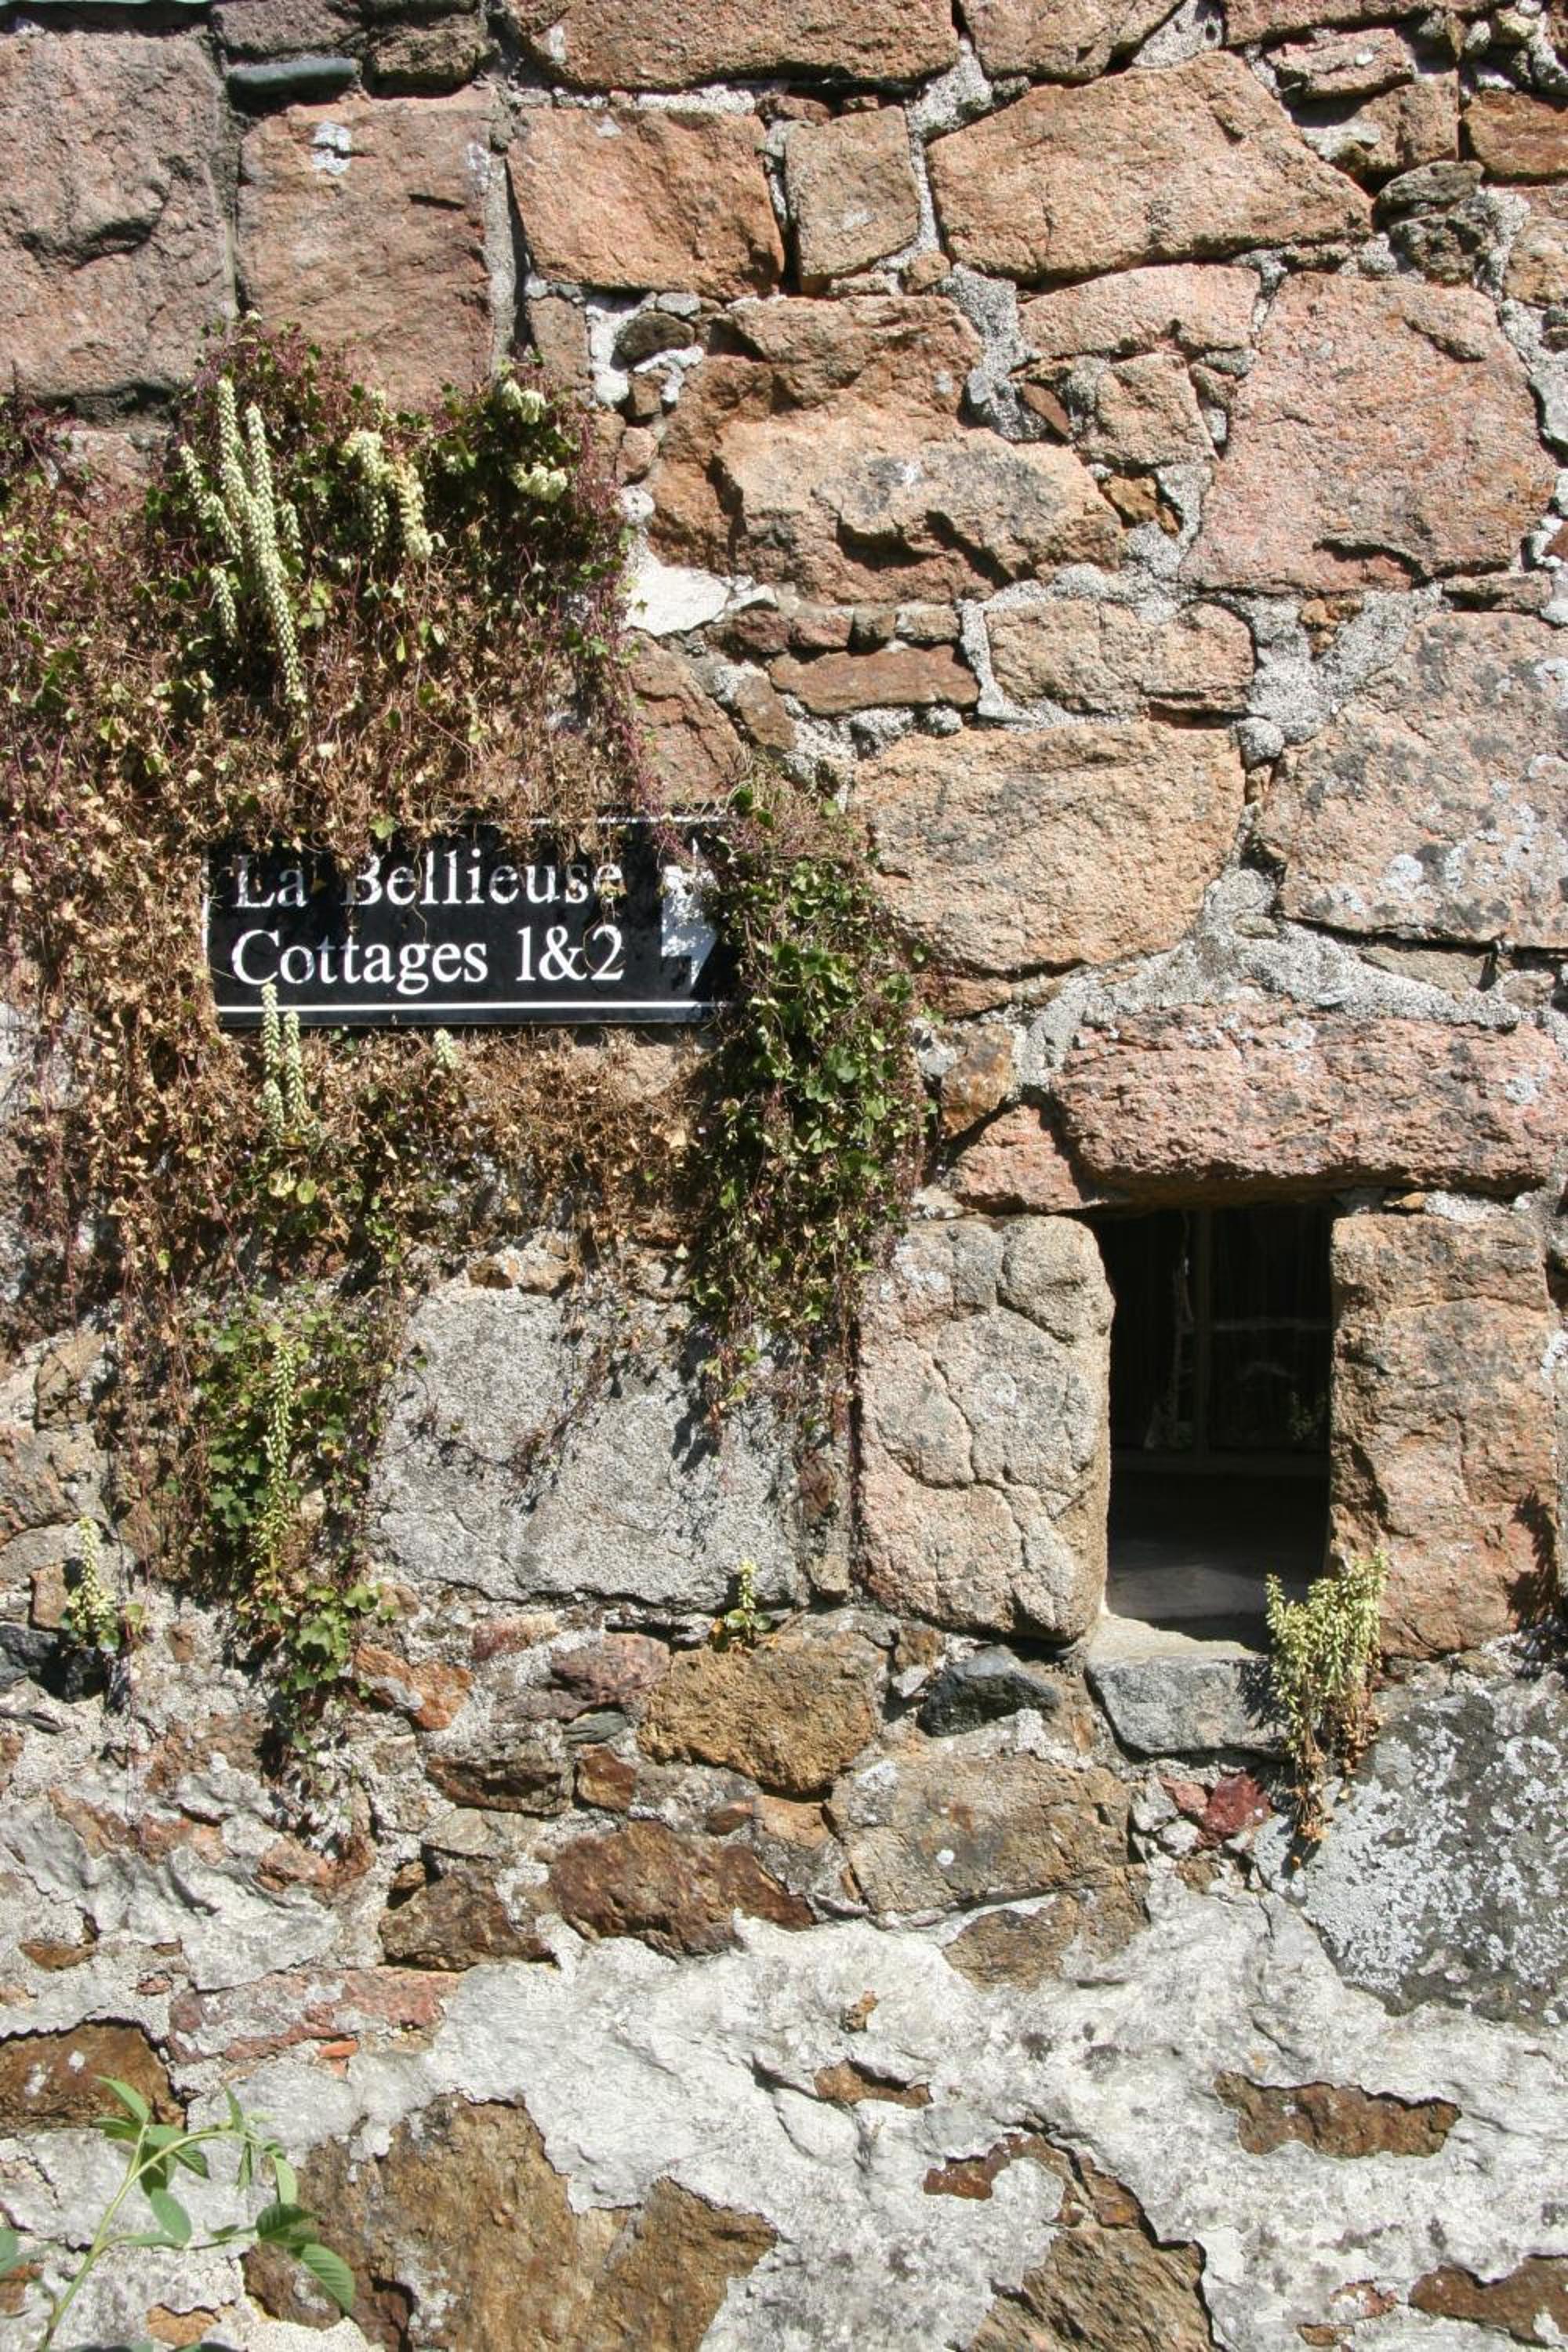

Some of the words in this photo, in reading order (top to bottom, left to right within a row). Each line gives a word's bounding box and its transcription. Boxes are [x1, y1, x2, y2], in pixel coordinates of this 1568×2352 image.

[232, 854, 308, 908] La
[340, 848, 623, 906] Bellieuse
[231, 929, 488, 994] Cottages
[516, 925, 625, 982] 1&2
